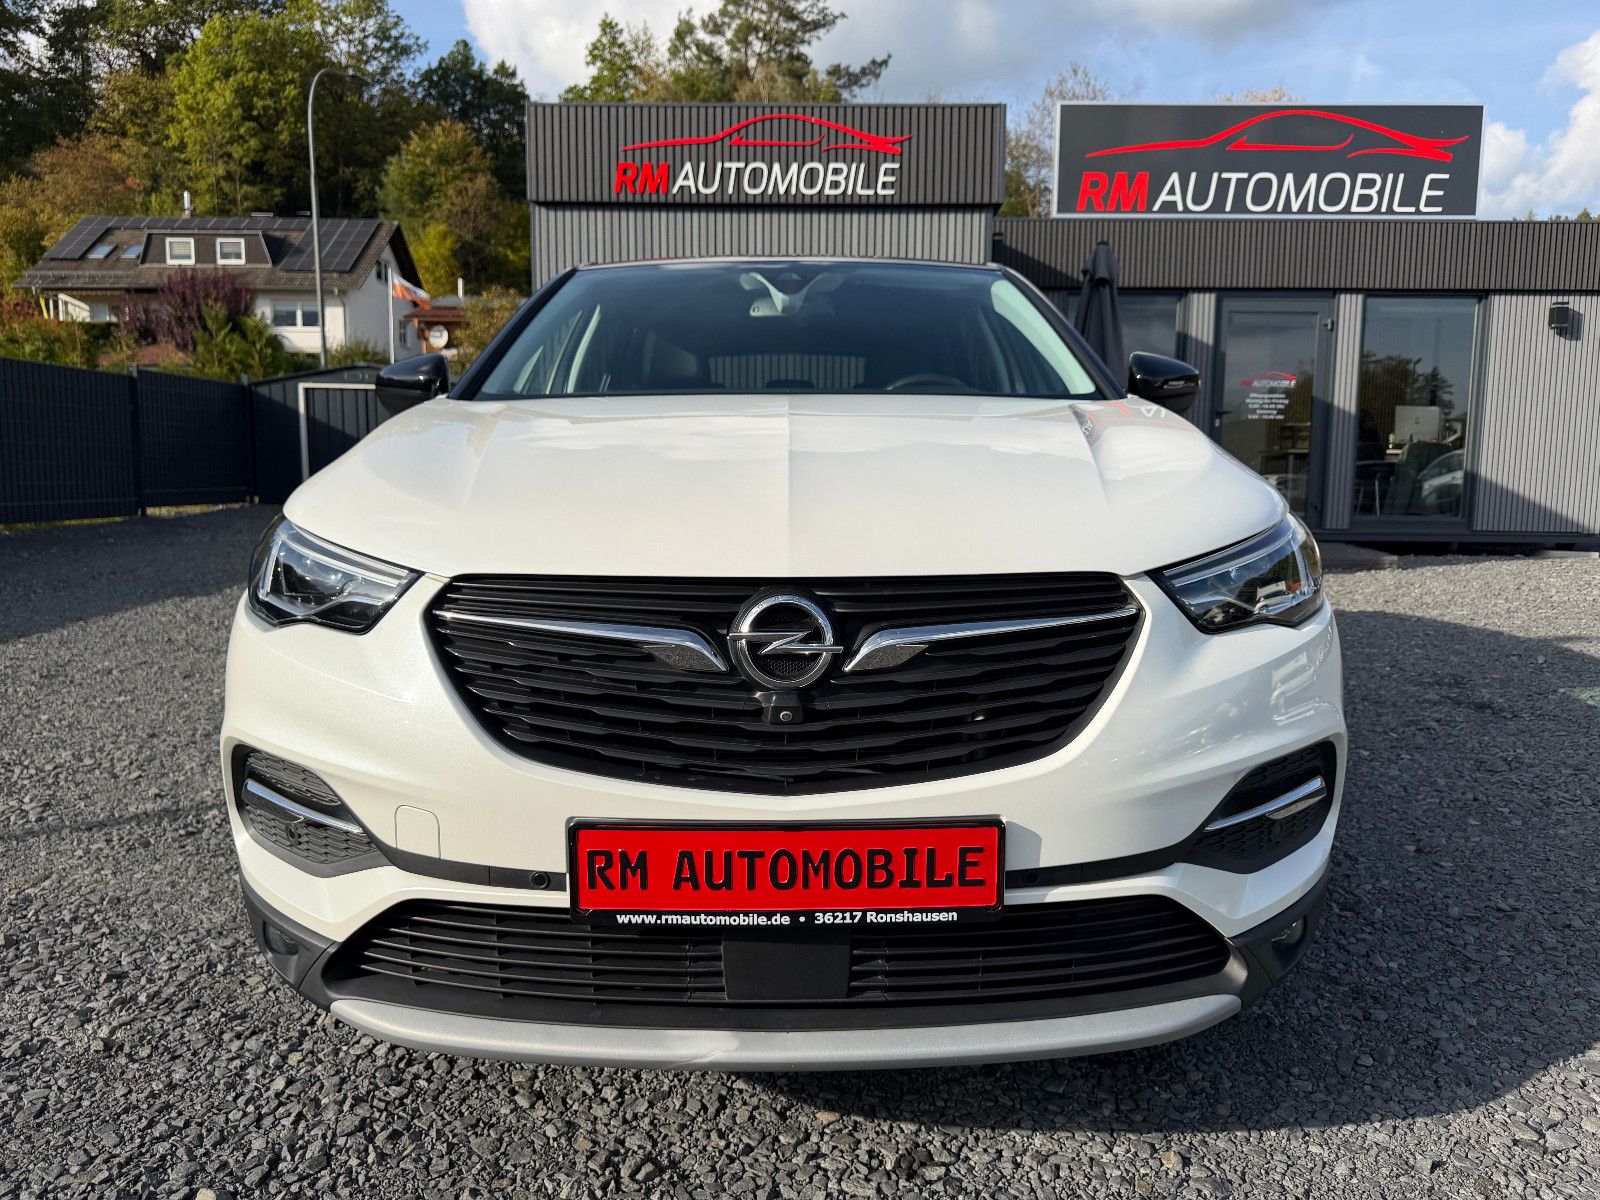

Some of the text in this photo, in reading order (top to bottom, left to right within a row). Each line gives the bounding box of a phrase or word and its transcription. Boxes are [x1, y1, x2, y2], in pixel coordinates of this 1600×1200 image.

[614, 161, 900, 196] RM AUTOMOBILE
[1076, 171, 1450, 213] RM AUTOMOBILE
[586, 846, 986, 891] RM AUTOMOBILE
[616, 910, 958, 926] www.rmautomobile.de 36217 Ronshausen
